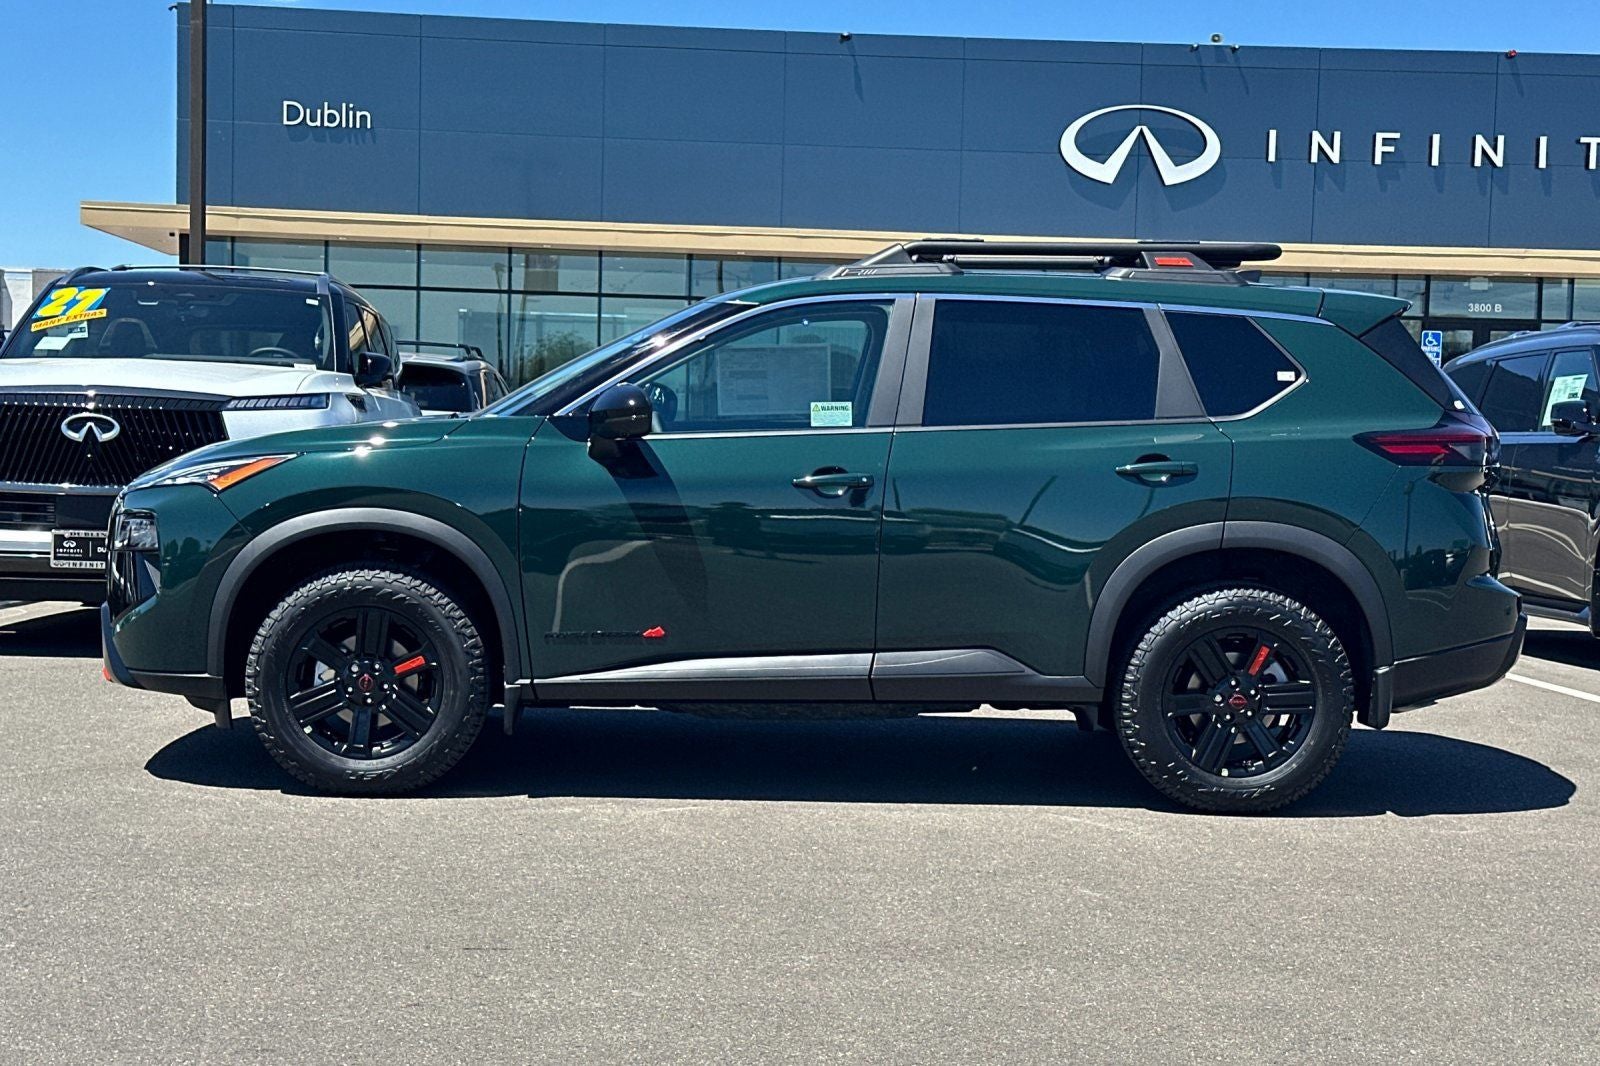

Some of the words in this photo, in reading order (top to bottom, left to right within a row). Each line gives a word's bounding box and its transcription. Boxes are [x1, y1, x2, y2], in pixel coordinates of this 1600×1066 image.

[282, 100, 371, 129] Dublin
[1267, 129, 1600, 170] INFINIT
[65, 310, 104, 320] EXTRAS
[1467, 303, 1492, 313] 3800
[1494, 303, 1503, 313] B
